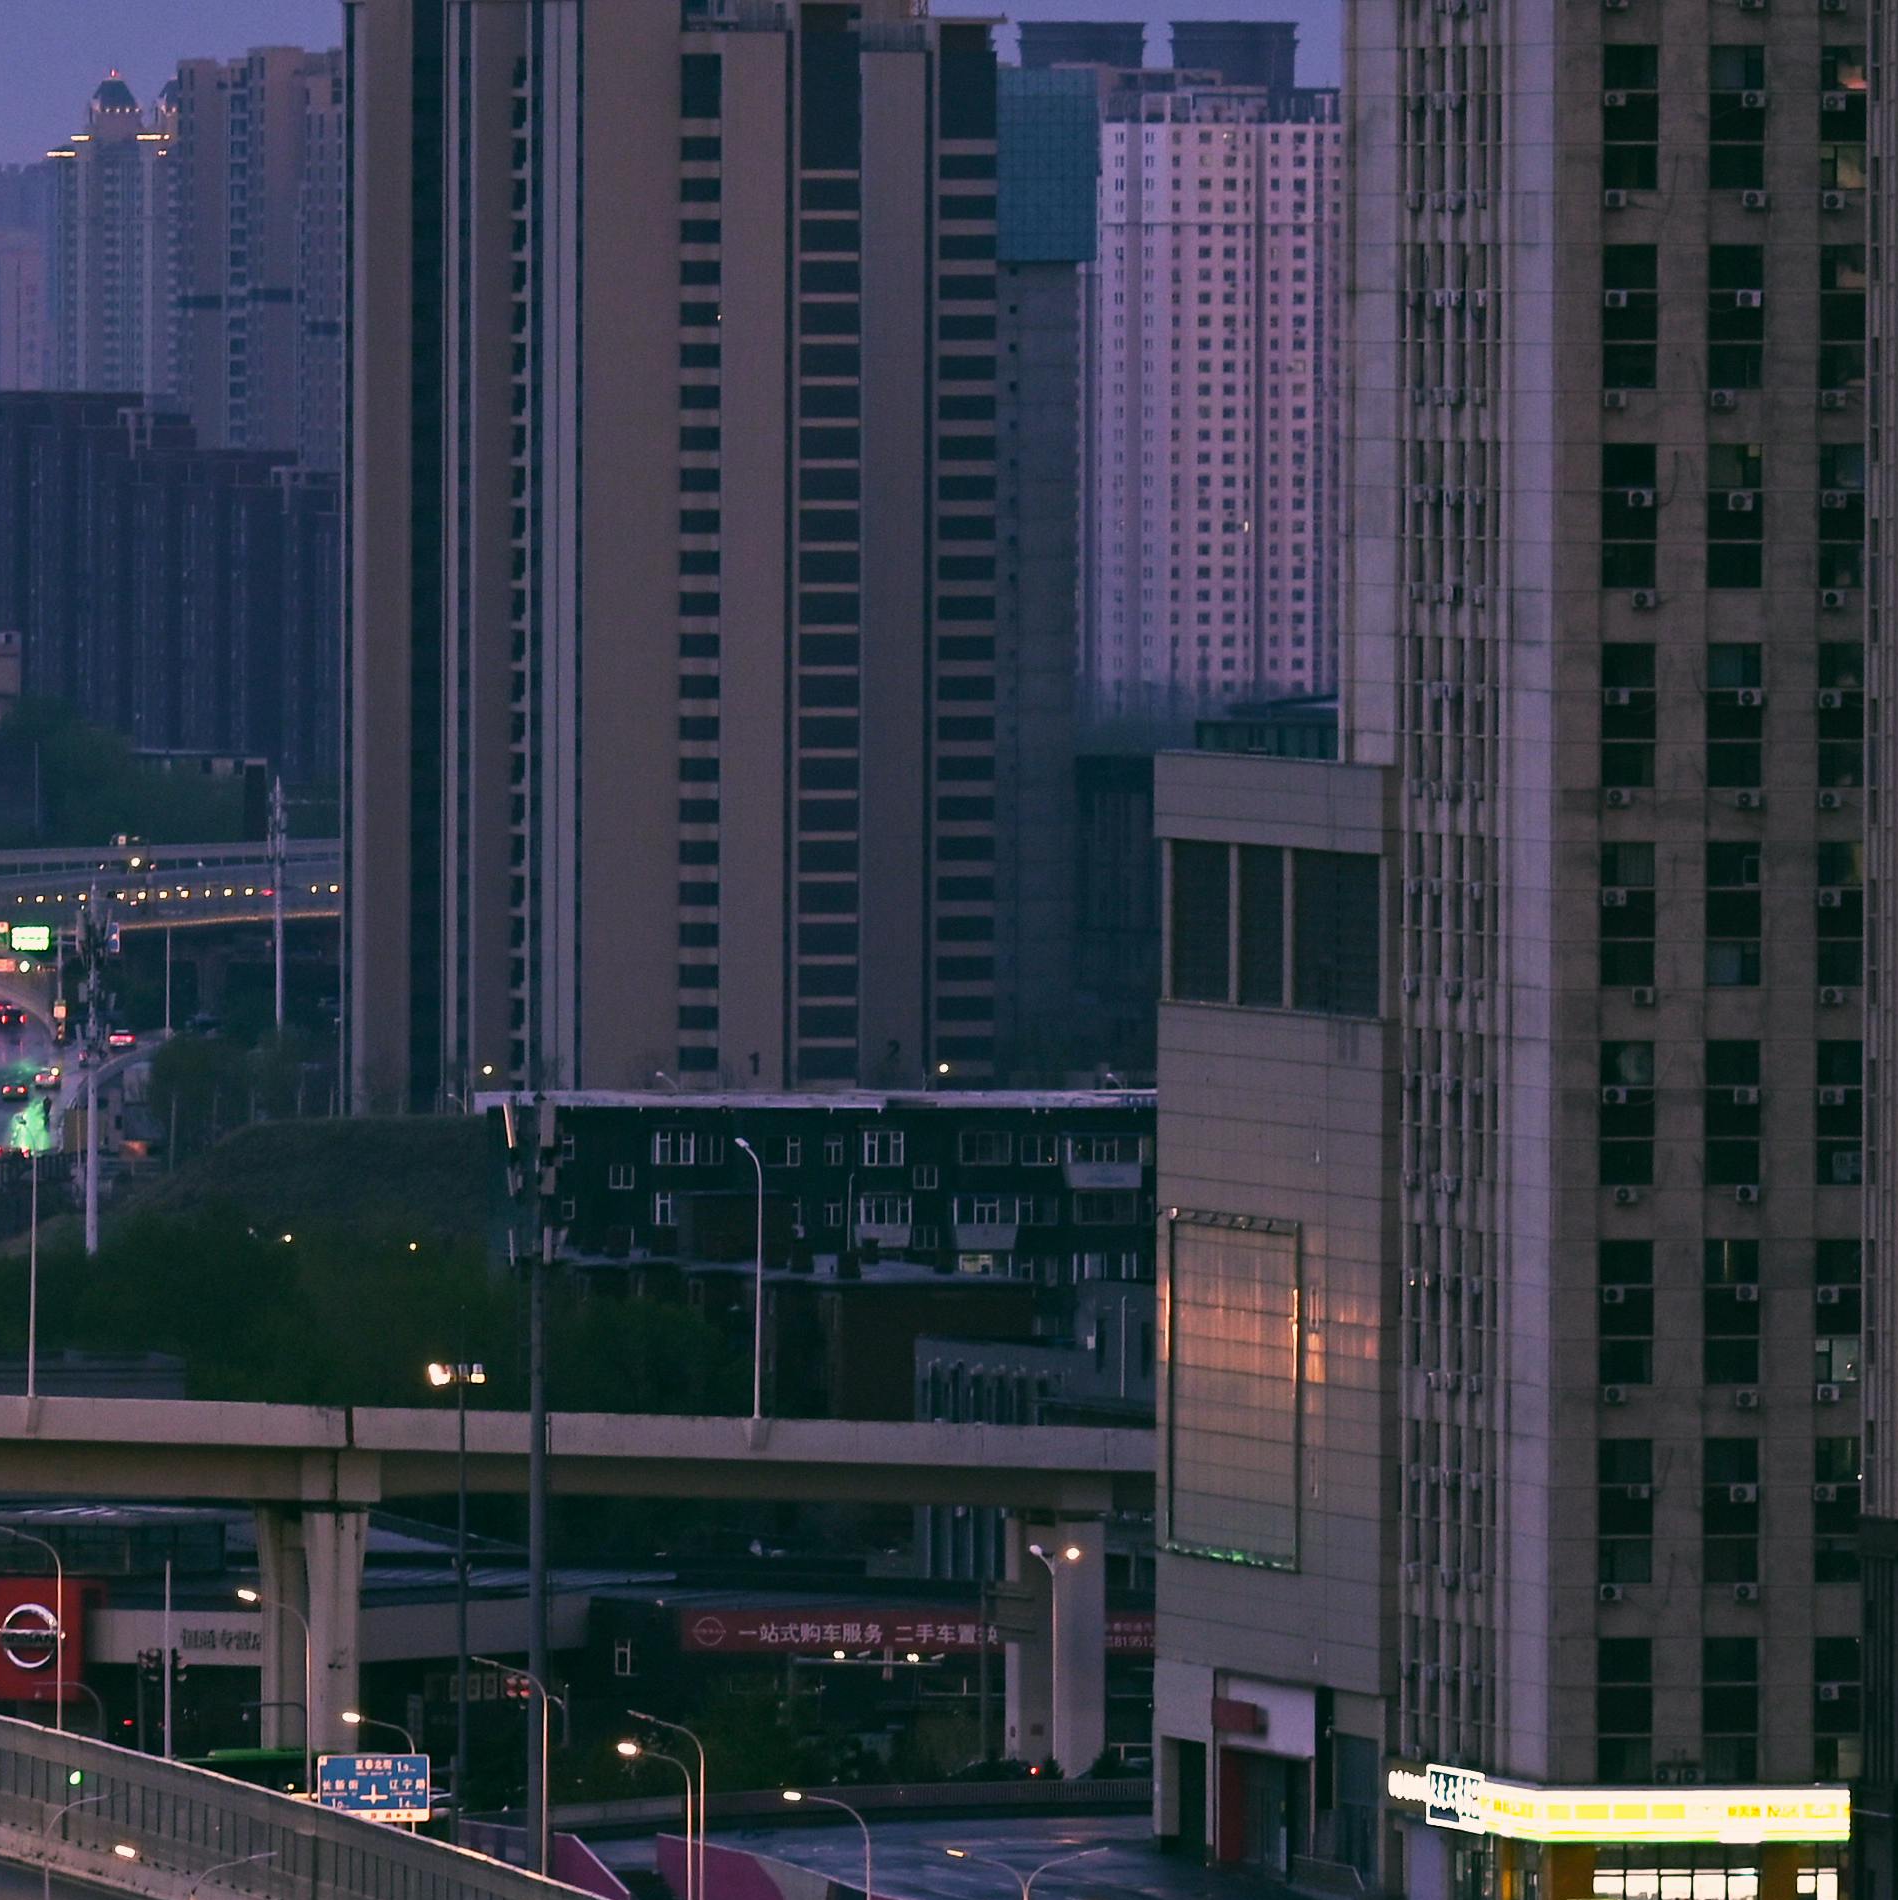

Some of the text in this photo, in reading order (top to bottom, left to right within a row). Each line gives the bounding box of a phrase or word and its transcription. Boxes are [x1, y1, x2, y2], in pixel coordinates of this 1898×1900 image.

[738, 1623, 884, 1644] 一站式购车服务
